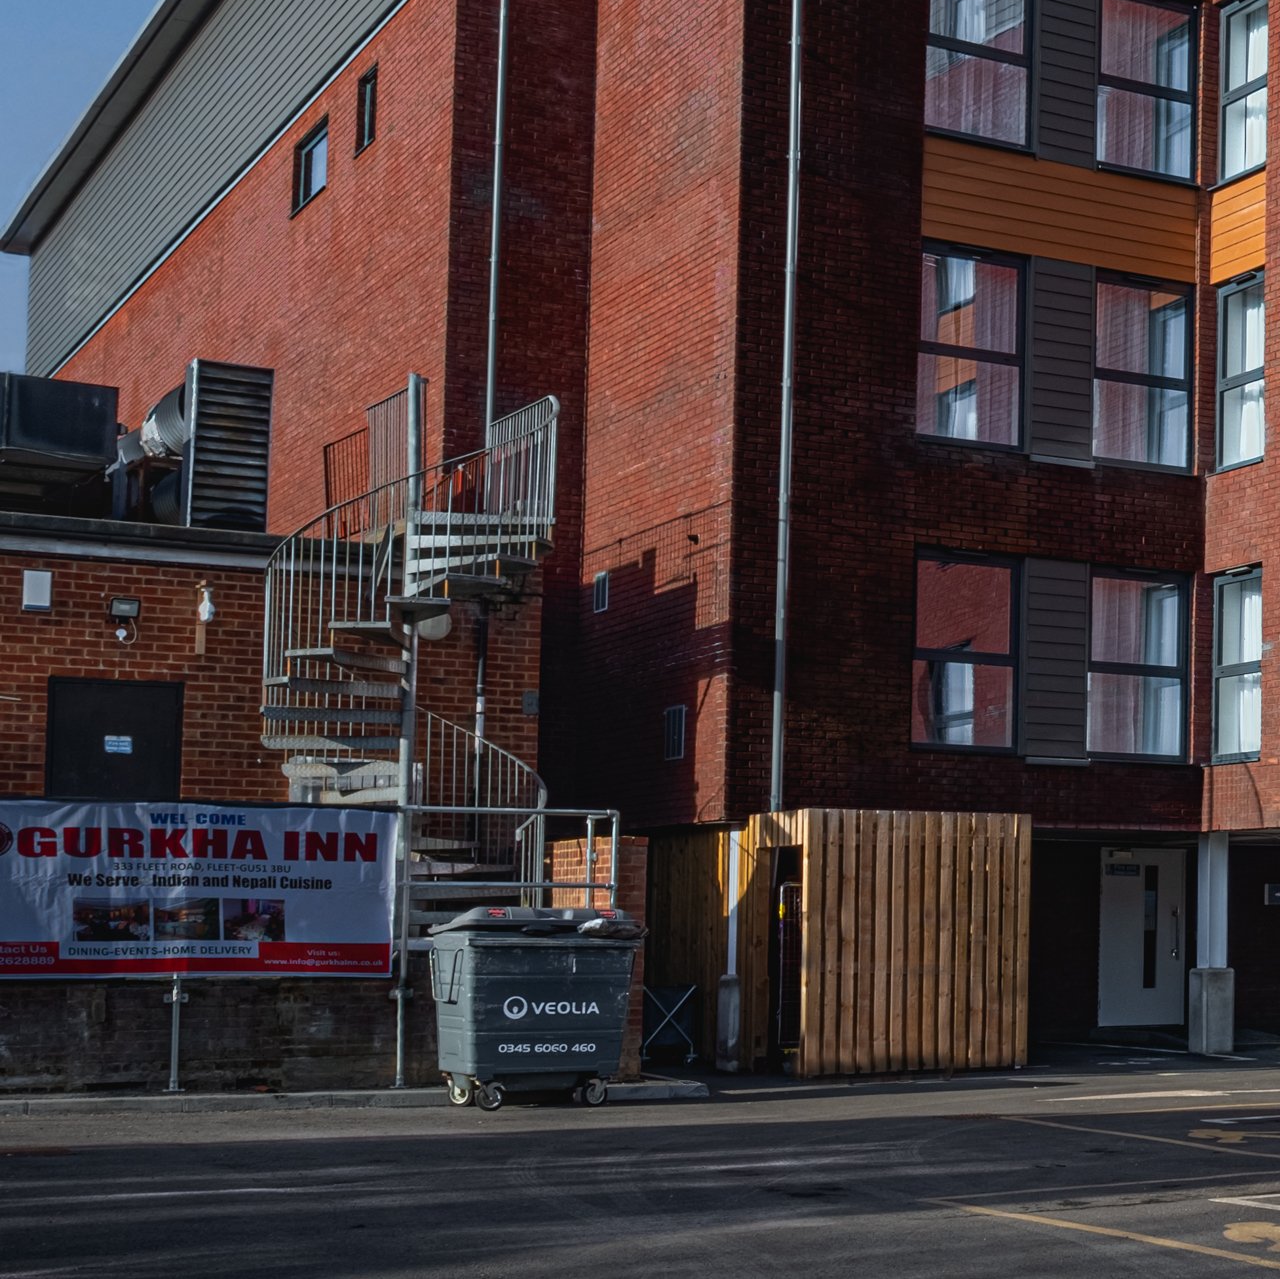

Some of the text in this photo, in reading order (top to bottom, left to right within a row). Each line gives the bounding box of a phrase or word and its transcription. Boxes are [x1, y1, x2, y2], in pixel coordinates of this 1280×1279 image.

[150, 813, 246, 826] WEL COME
[17, 826, 268, 861] GURKHA
[284, 831, 378, 862] INN
[113, 862, 133, 871] 333
[137, 863, 167, 871] FLEET
[170, 863, 204, 872] ROAD,
[270, 864, 291, 873] 3BU
[68, 873, 332, 890] We Serve Indian and Nepali Cuisine
[29, 945, 48, 954] Us
[68, 945, 252, 956] DINING-EVENTS-HOME DELIVERY
[306, 949, 326, 957] Visit
[531, 1001, 600, 1015] VEOLIA
[498, 1043, 596, 1053] 0345 6060 460
